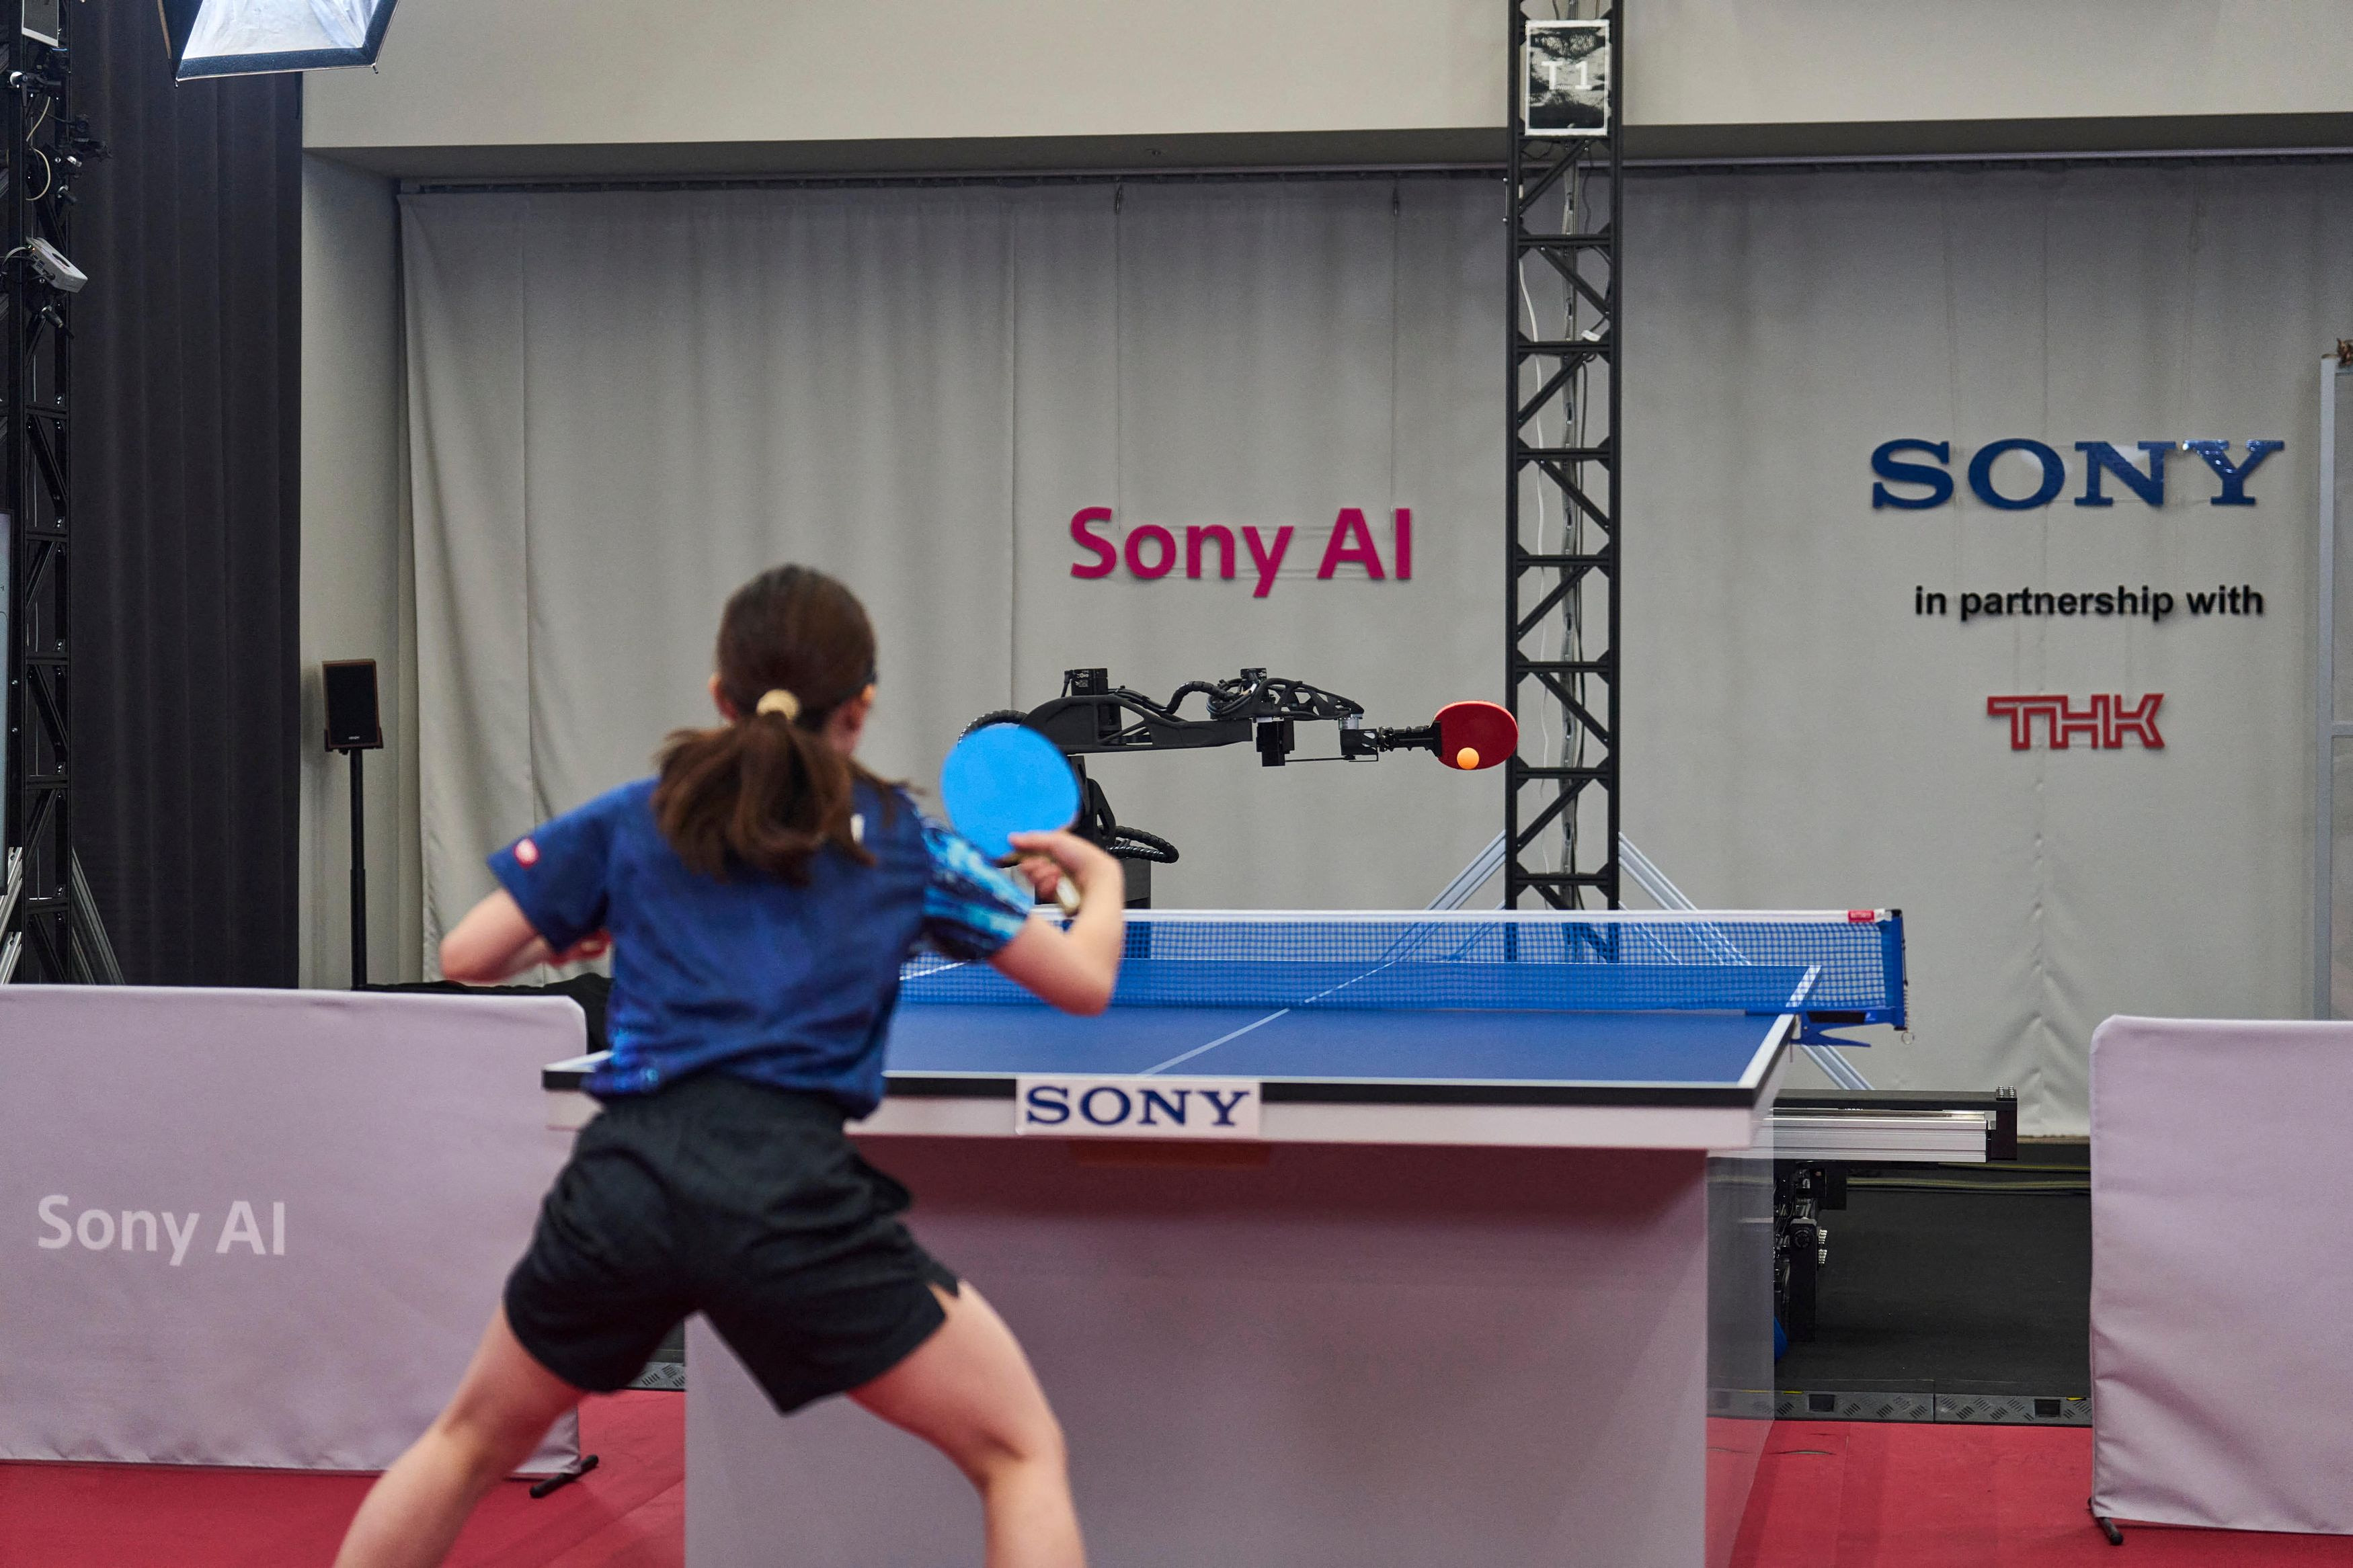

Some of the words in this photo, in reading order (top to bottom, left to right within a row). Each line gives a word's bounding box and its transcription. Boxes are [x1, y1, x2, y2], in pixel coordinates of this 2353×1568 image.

[1871, 438, 2285, 510] SONY
[1070, 506, 1294, 597] Sony
[1316, 507, 1411, 579] AI
[1915, 585, 1946, 615] in
[1960, 585, 2174, 622] partnership
[2186, 585, 2264, 615] with
[1987, 693, 2165, 750] THK
[1026, 1085, 1250, 1126] SONY
[38, 1194, 200, 1266] Sony
[215, 1200, 285, 1255] AI
